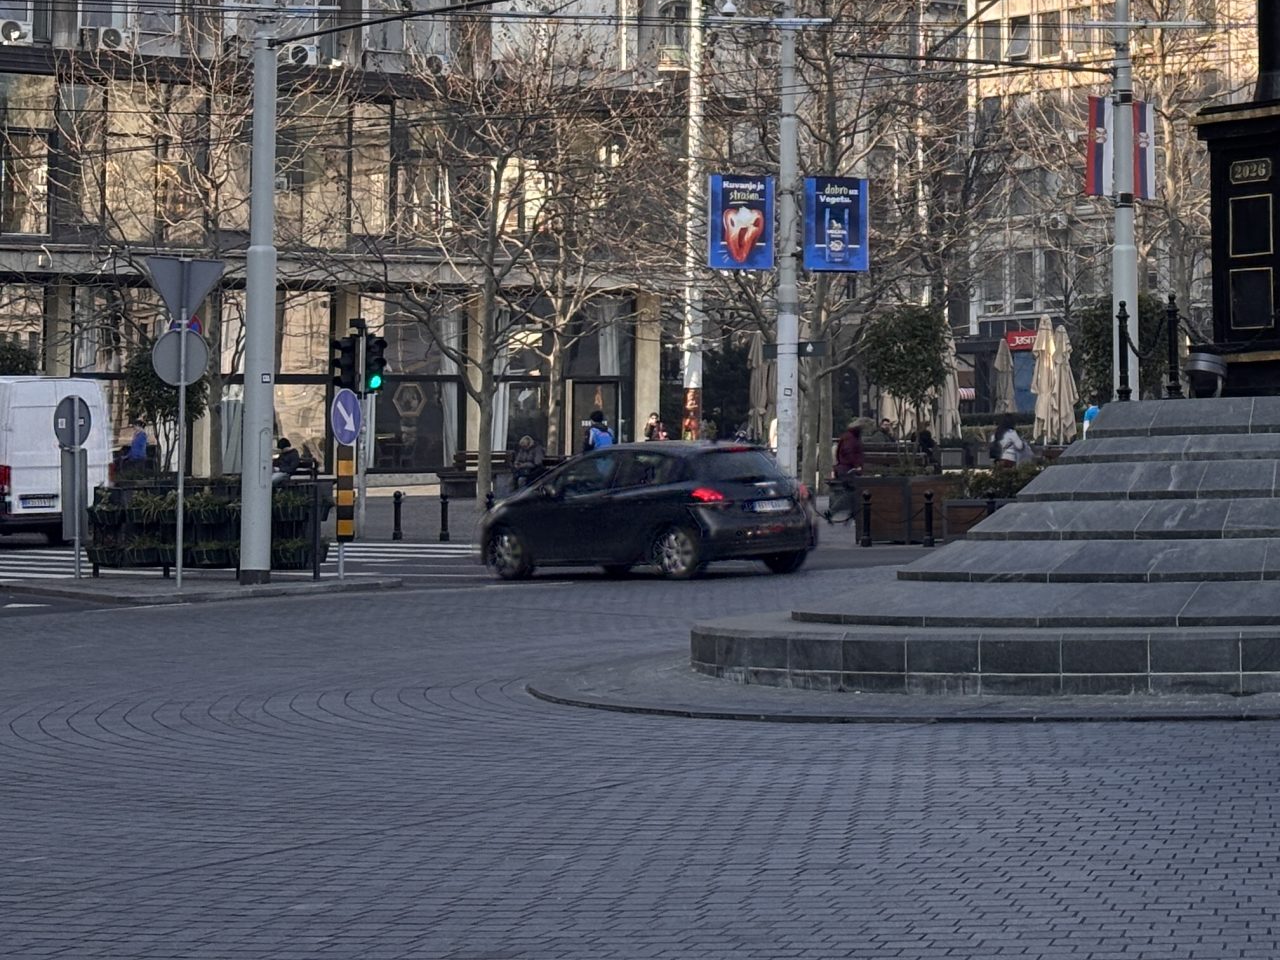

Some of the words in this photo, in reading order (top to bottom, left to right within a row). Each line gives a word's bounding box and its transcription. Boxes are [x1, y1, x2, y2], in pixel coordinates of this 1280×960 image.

[1234, 162, 1266, 179] 2026
[723, 181, 756, 191] Kuvanje
[756, 181, 765, 191] je
